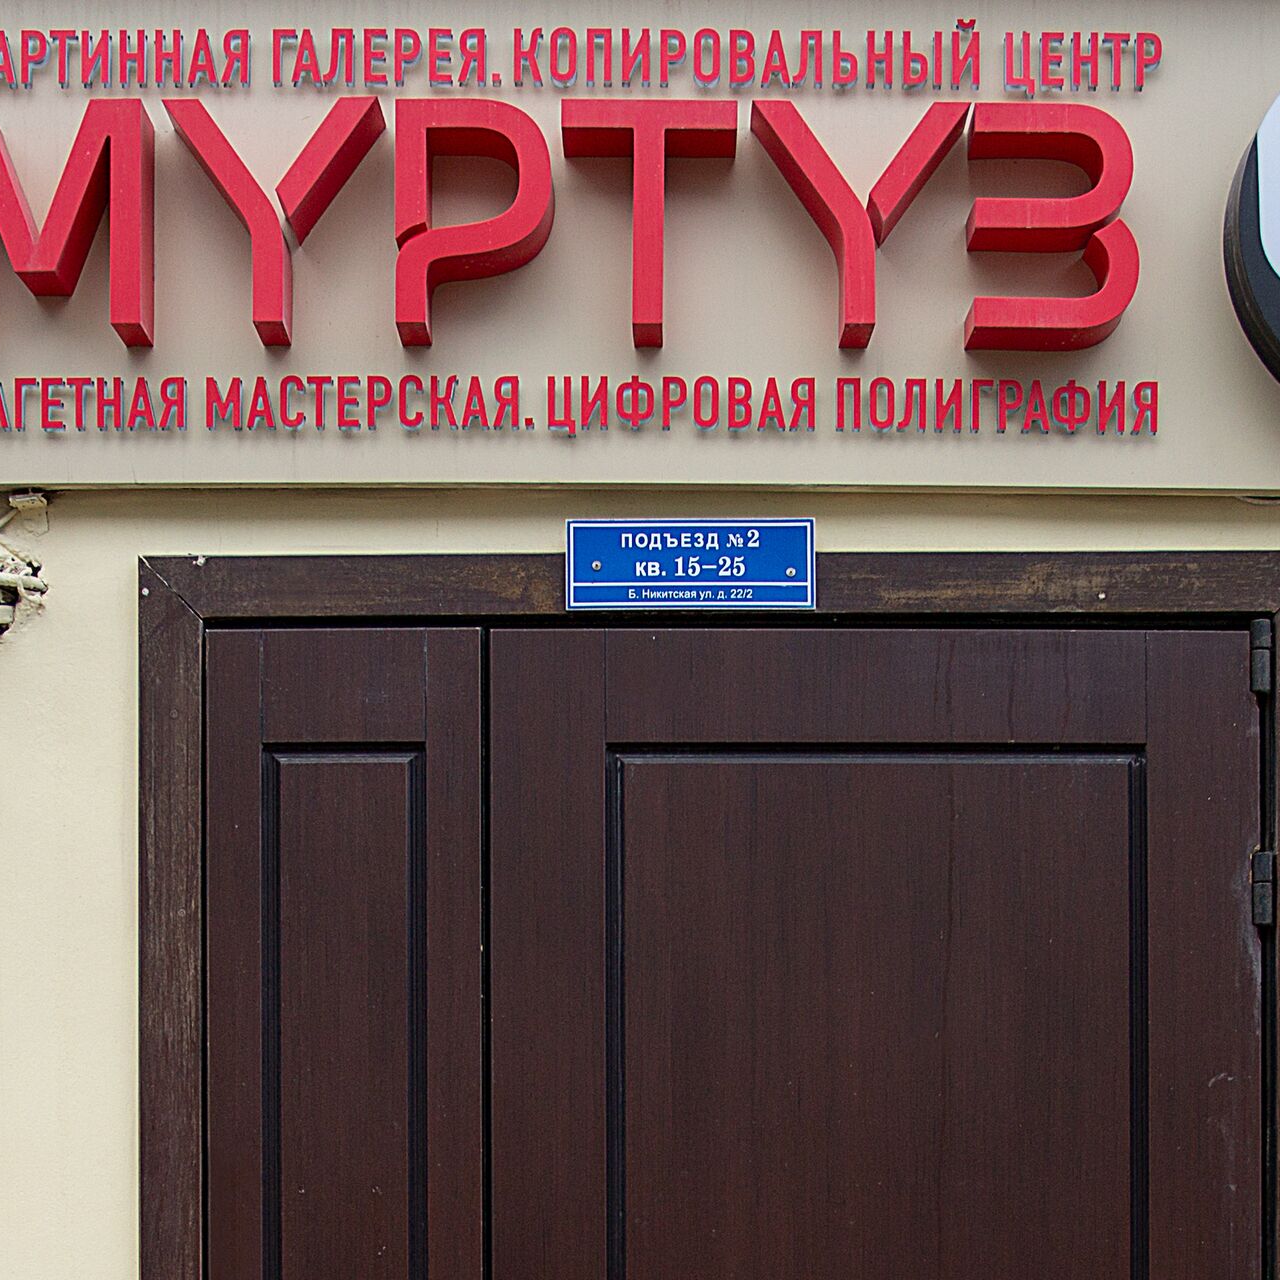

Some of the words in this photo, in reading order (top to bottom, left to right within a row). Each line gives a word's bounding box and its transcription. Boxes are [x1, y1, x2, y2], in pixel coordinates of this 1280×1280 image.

[271, 26, 502, 89] ГАЛЕРЕЯ.
[520, 19, 982, 91] КОПИРОВАЛЬНЫЙ
[1002, 30, 1164, 94] ЦЕНТР
[204, 374, 535, 431] МАСТЕРСКАЯ.
[546, 375, 817, 436] ЦИФРОВАЯ
[836, 377, 1160, 436] ПОЛИГРАФИЯ
[621, 533, 719, 549] ПОДЪЕЗД
[628, 589, 638, 599] Б.
[642, 589, 697, 598] Никитская
[699, 590, 715, 600] ул.
[717, 591, 727, 600] д.
[731, 589, 752, 599] 22/2
